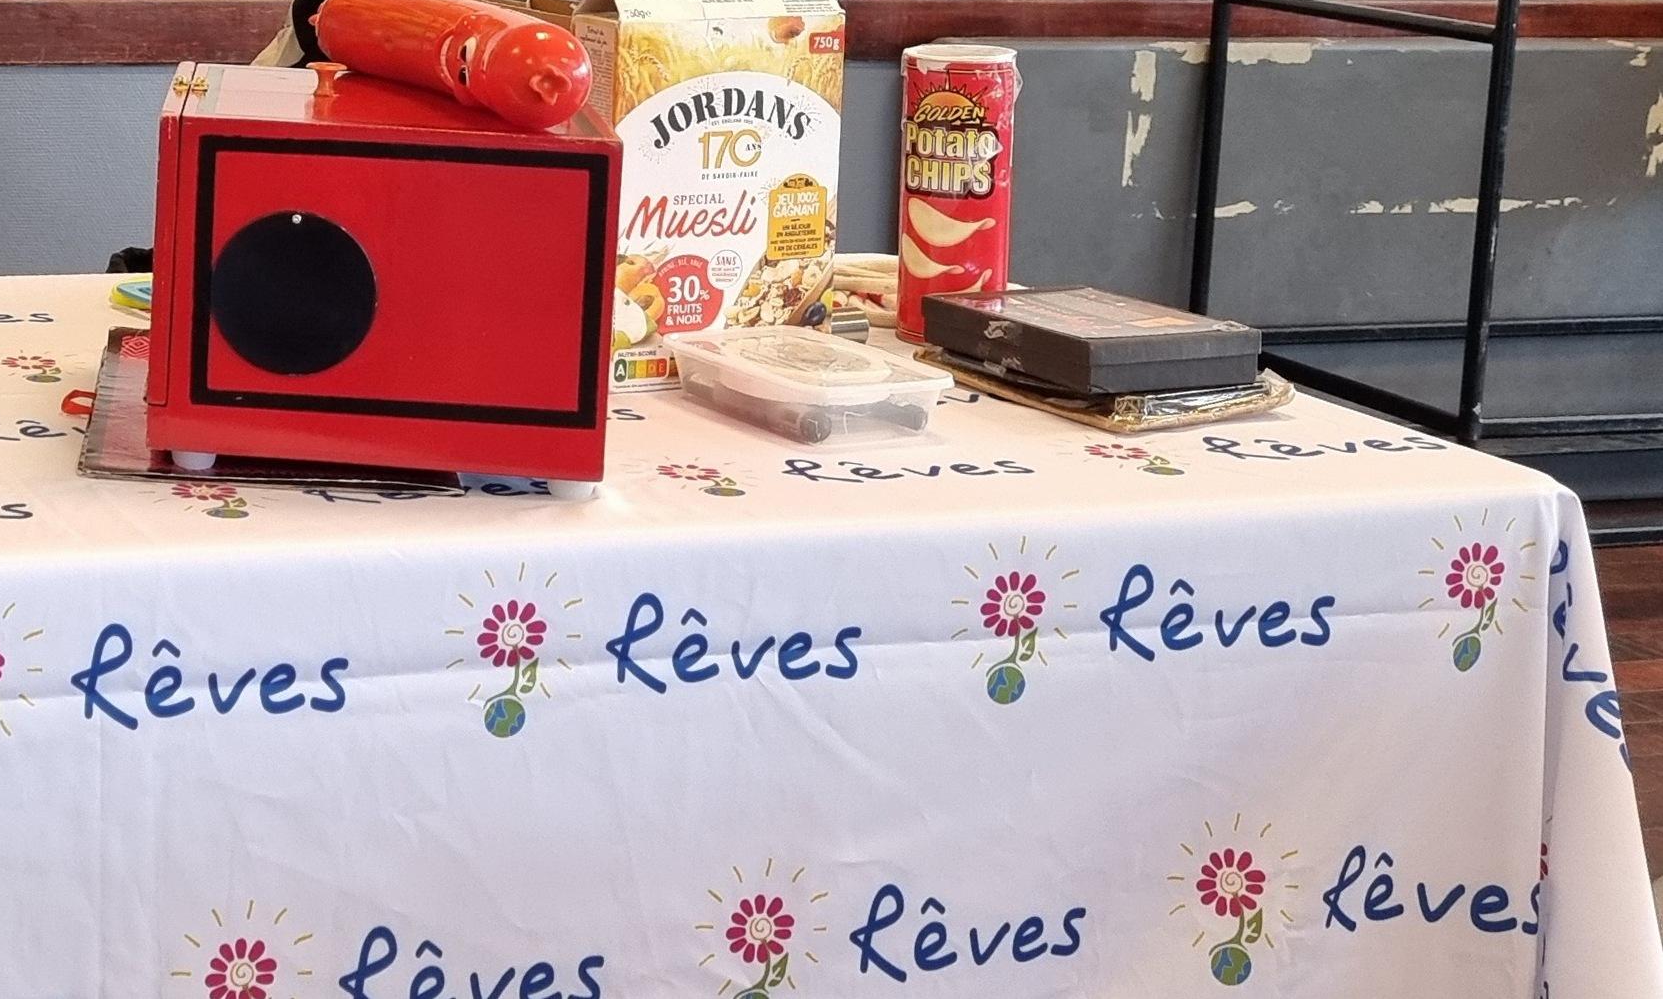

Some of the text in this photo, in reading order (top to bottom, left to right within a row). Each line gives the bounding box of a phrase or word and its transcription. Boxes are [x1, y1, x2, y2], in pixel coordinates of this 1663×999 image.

[813, 36, 841, 51] 750g
[650, 87, 811, 149] JORDANS
[913, 103, 986, 123] GOLDEN
[698, 129, 762, 169] 170
[904, 121, 997, 159] Potato
[906, 155, 992, 195] CHIPS
[715, 256, 737, 266] SANS
[665, 314, 703, 326] & NOIX
[667, 303, 703, 315] FRUITS
[1099, 563, 1336, 662] Rêves
[605, 592, 863, 695] Rêves
[71, 623, 349, 731] Rêves
[848, 883, 1087, 983] Rêves
[338, 925, 605, 999] Rêves
